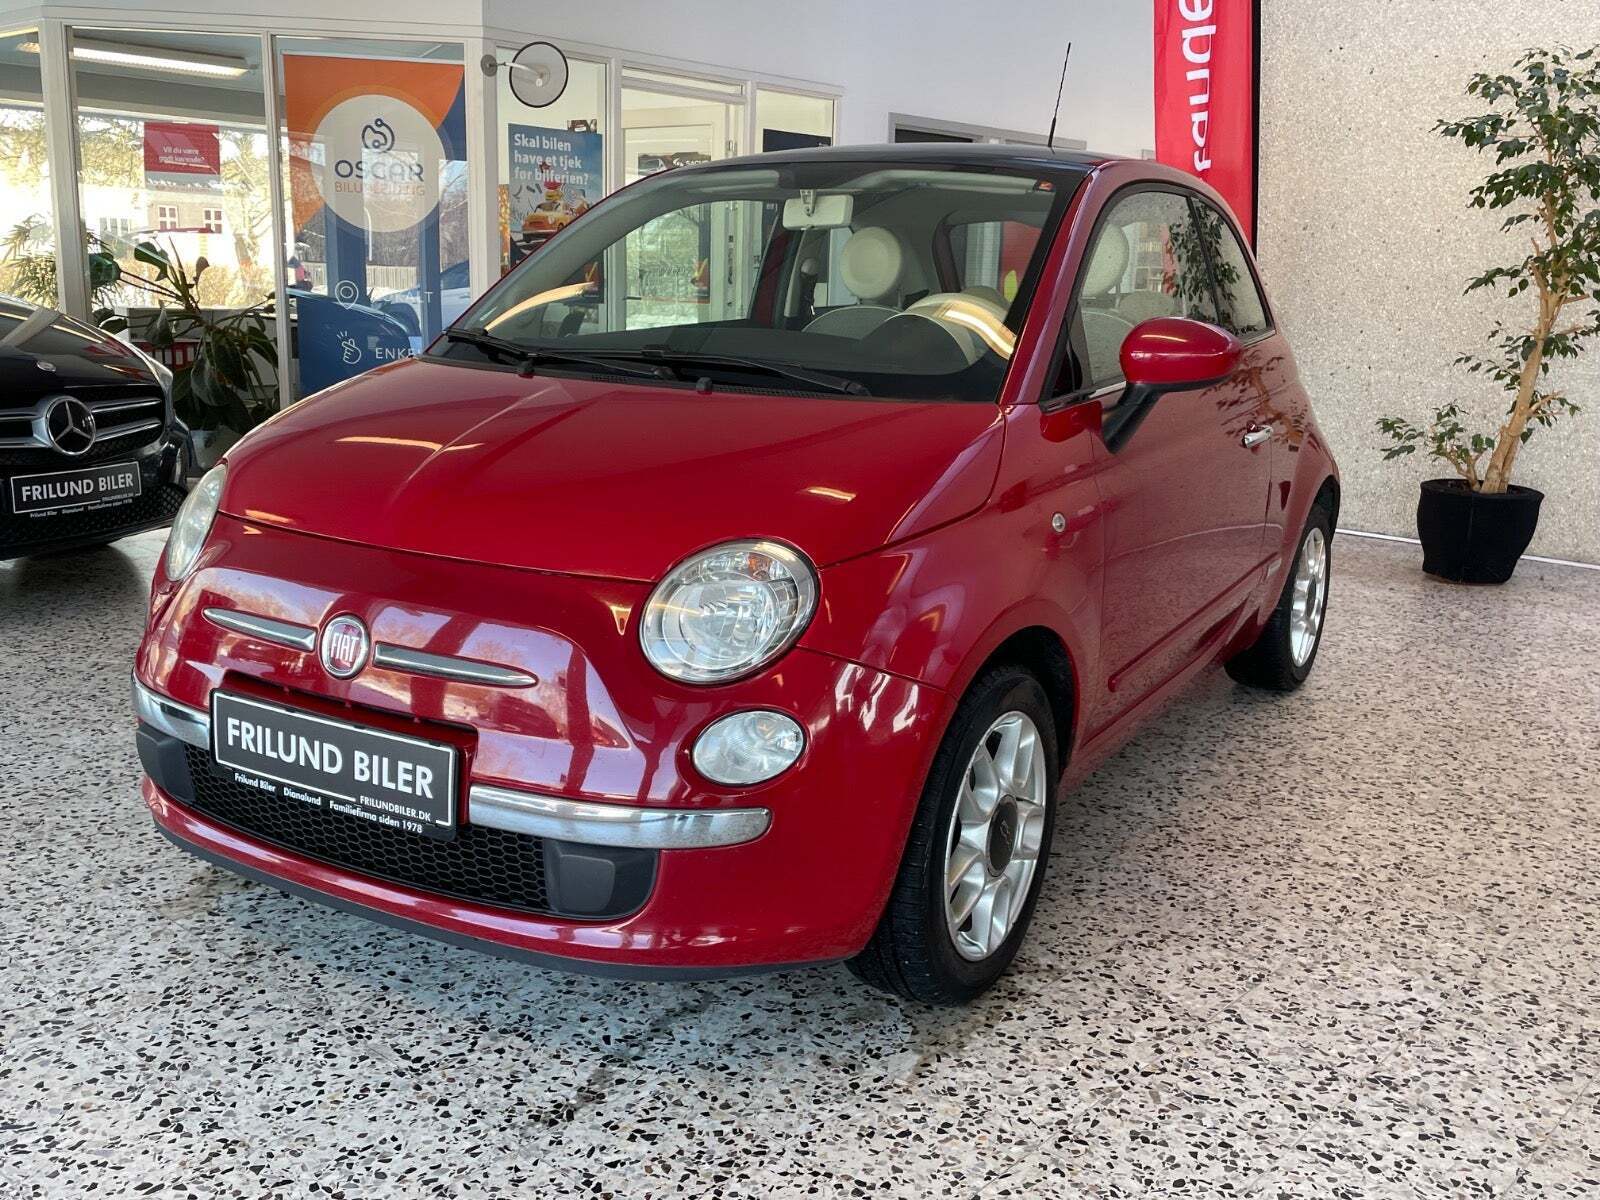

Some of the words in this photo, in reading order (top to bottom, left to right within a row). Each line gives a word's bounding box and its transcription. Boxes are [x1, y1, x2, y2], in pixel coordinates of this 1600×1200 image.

[514, 133, 540, 148] Skal
[542, 136, 572, 152] bilen
[335, 160, 424, 182] OSCAR
[514, 150, 543, 164] have
[545, 155, 557, 166] et
[560, 155, 582, 170] tjek
[514, 166, 532, 180] for
[534, 168, 589, 185] bilferien?
[22, 479, 94, 501] FRILUND
[98, 473, 134, 491] BILER
[331, 632, 360, 662] FIAT
[227, 716, 343, 775] FRILUND
[353, 750, 433, 799] BILER
[234, 772, 258, 788] Frilund
[259, 780, 276, 792] Biler
[283, 787, 321, 806] Dianalund
[329, 800, 377, 822] Familiefirma
[379, 814, 400, 828] siden
[402, 820, 423, 833] 1978
[360, 795, 431, 822] FRILUNDBILER.DK
